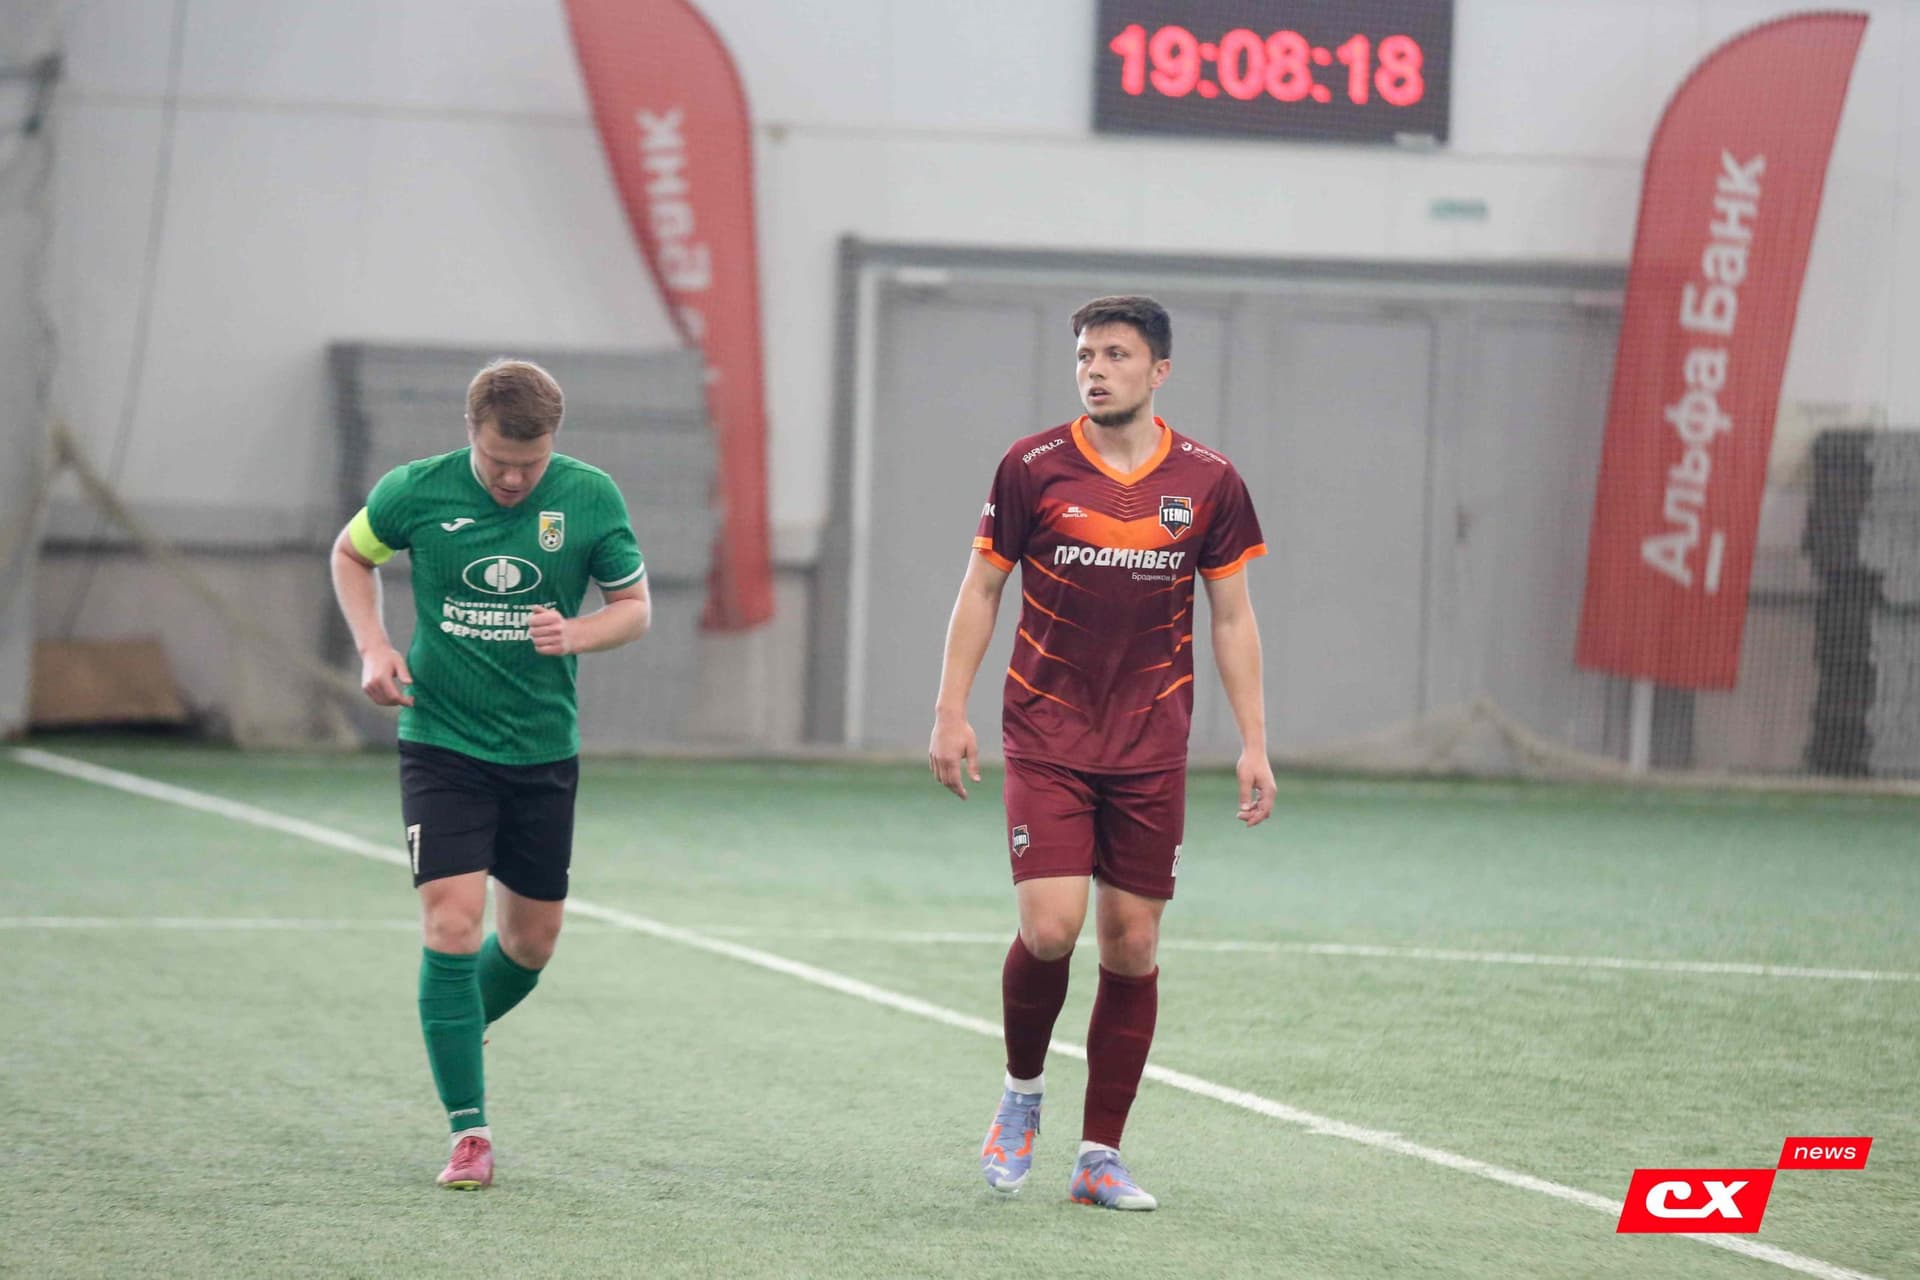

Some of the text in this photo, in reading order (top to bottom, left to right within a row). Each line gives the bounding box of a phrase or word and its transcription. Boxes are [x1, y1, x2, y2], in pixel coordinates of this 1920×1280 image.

[1109, 24, 1425, 107] 19:08:18
[1641, 149, 1766, 587] Альфа Банк
[1162, 508, 1190, 525] ТЕМП
[1054, 545, 1186, 570] ПРОДИНВЕСТ
[442, 603, 534, 629] КУЗНЕЦК
[440, 621, 534, 641] ФЕРРОСПЛА
